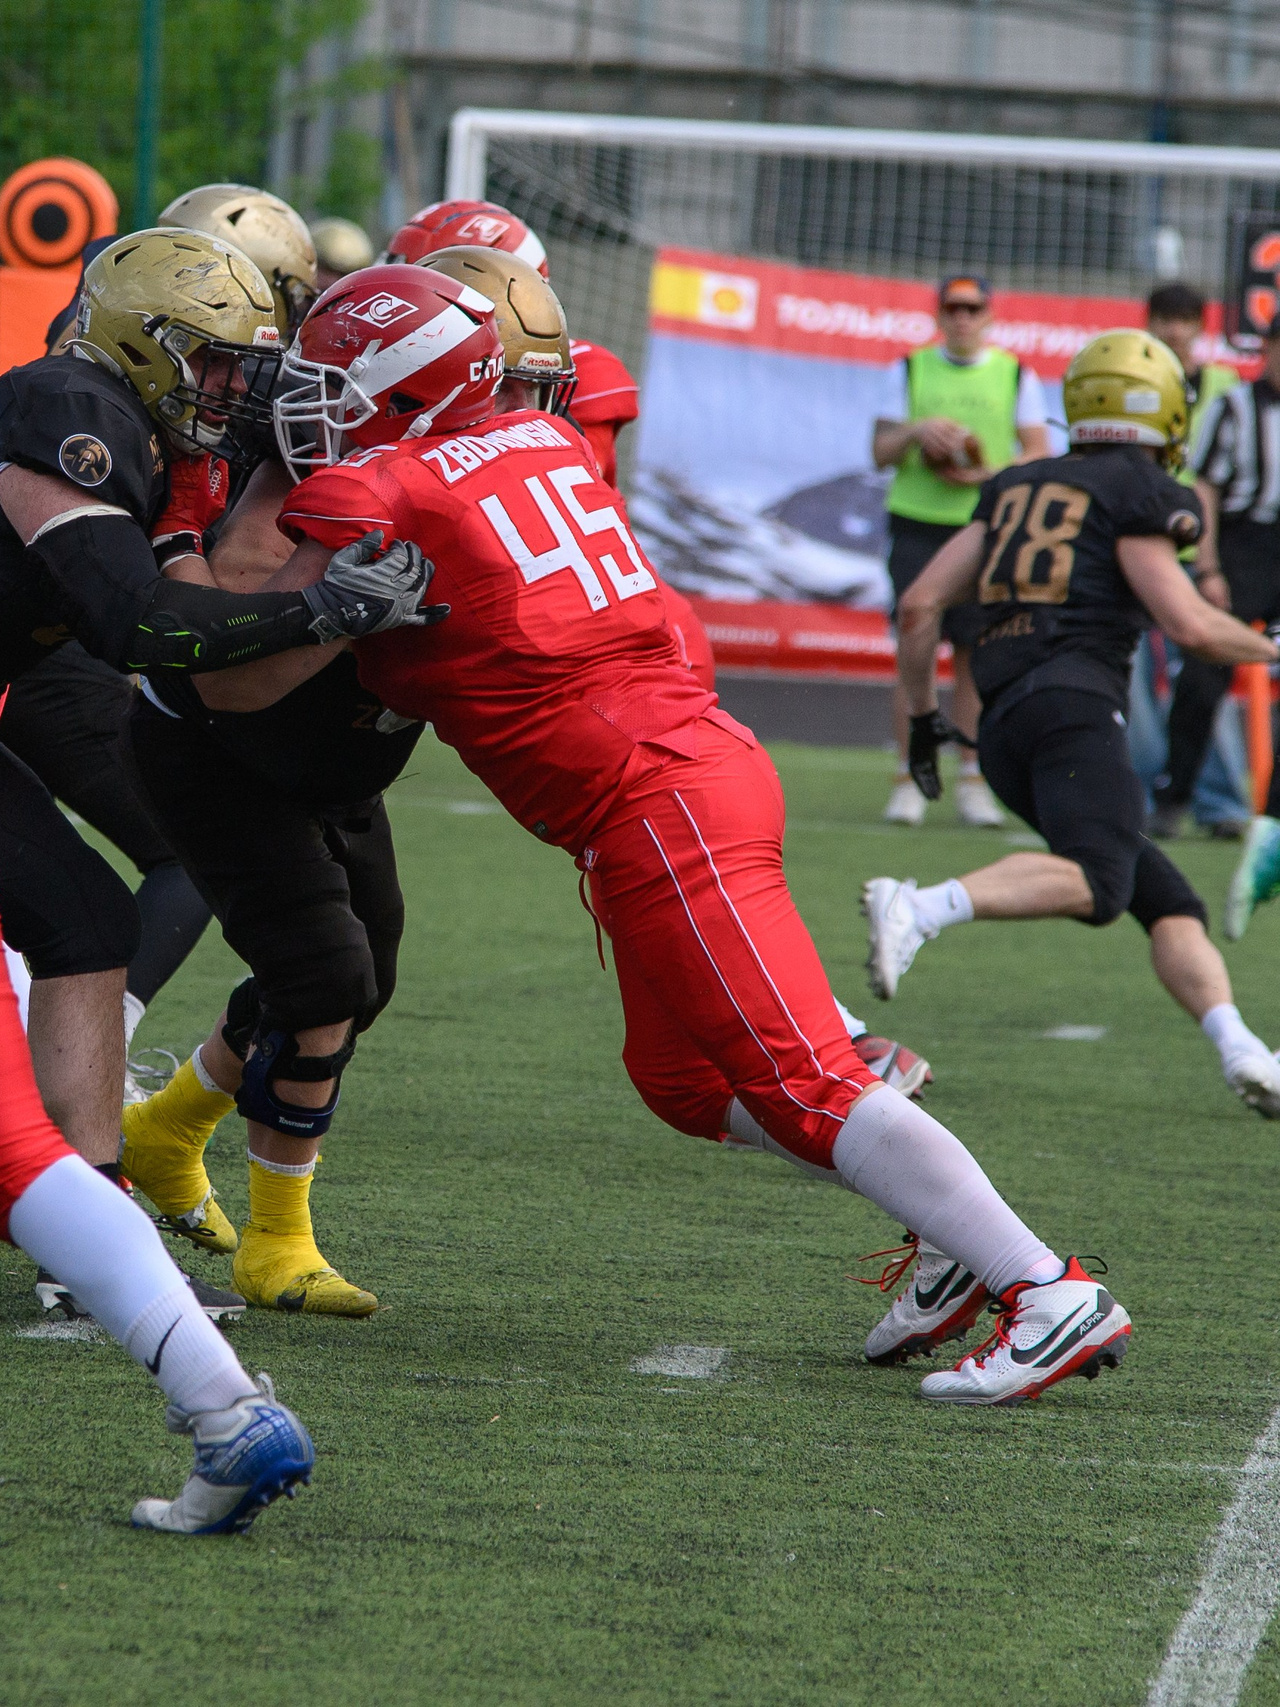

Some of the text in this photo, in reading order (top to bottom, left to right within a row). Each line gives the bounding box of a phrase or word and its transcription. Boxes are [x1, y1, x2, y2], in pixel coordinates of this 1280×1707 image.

[1077, 427, 1138, 441] Riddell
[477, 464, 658, 613] 45
[978, 481, 1092, 605] 28
[278, 1116, 314, 1129] Townsend
[1079, 1312, 1106, 1336] ALPHA
